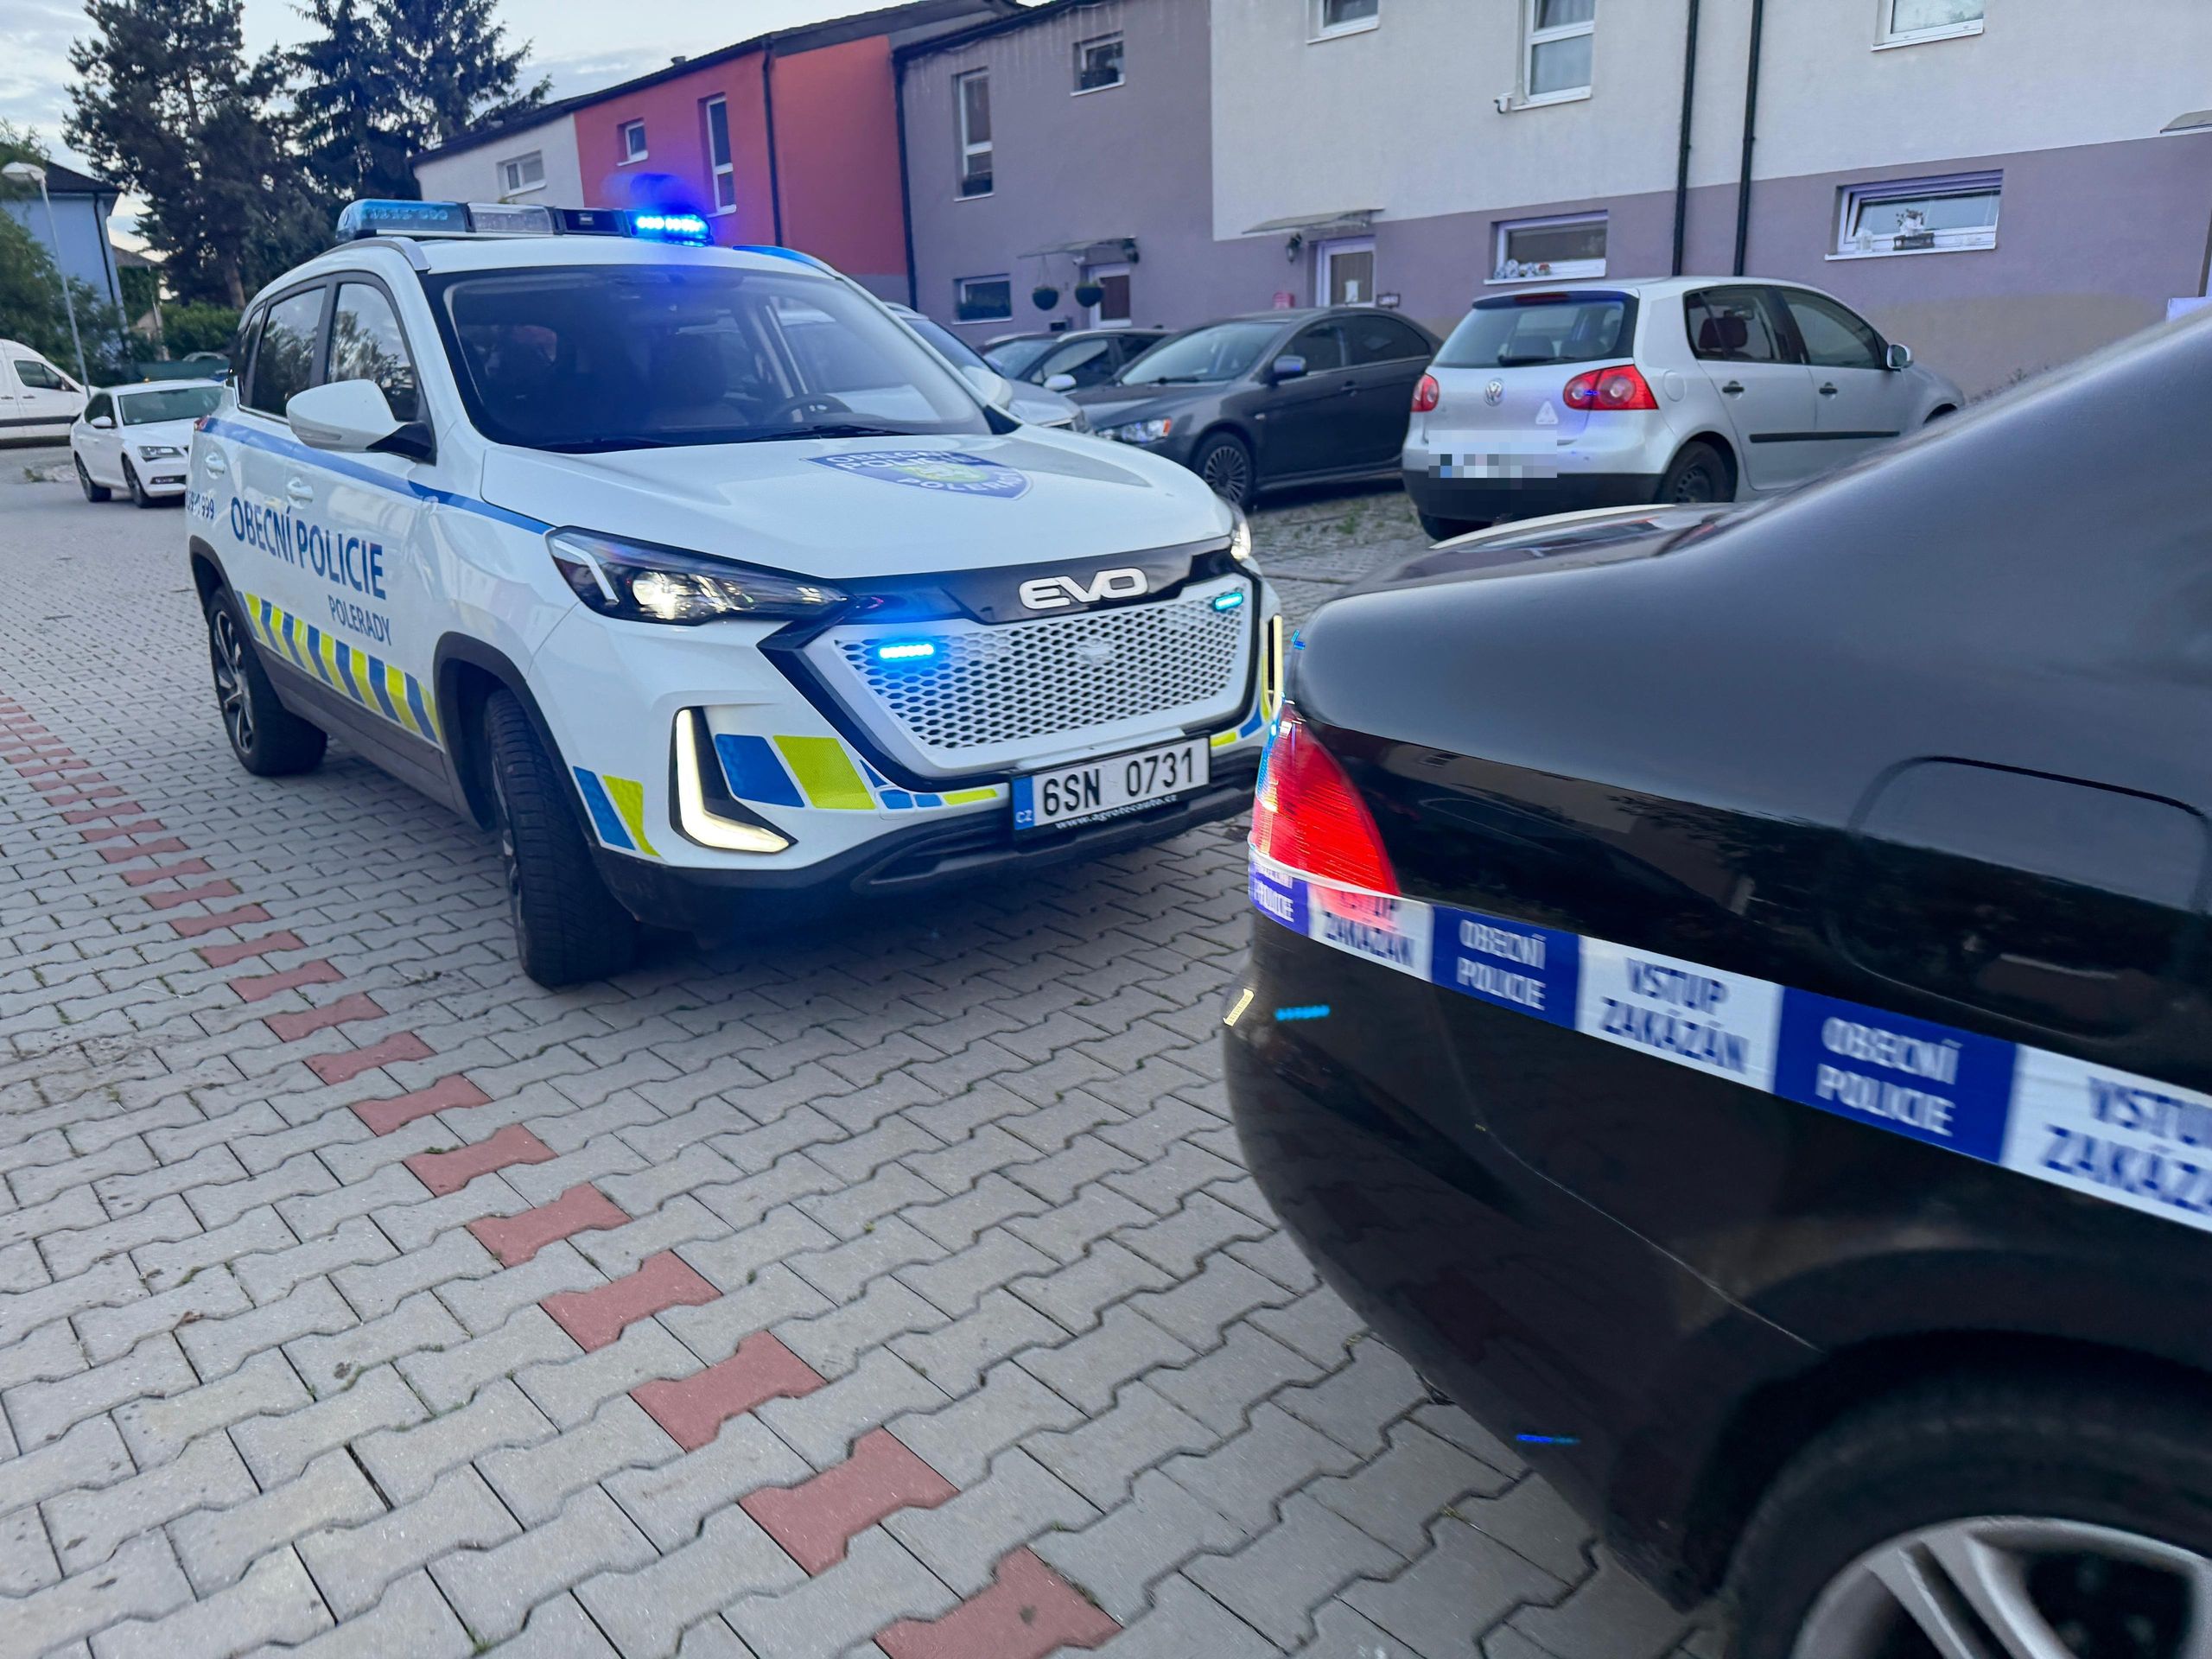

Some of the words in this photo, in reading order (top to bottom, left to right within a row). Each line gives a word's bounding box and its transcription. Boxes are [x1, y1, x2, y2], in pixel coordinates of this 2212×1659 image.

[231, 497, 295, 564] OBECNÍ
[296, 520, 386, 601] POLICIE
[1019, 568, 1149, 610] EVO
[327, 594, 392, 646] POLERADY
[1043, 768, 1101, 817] 6SN
[1126, 747, 1193, 798] 0731
[1015, 809, 1033, 823] CZ
[1459, 918, 1547, 970] OBECNÍ
[1821, 1017, 1963, 1085] OBECNÍ
